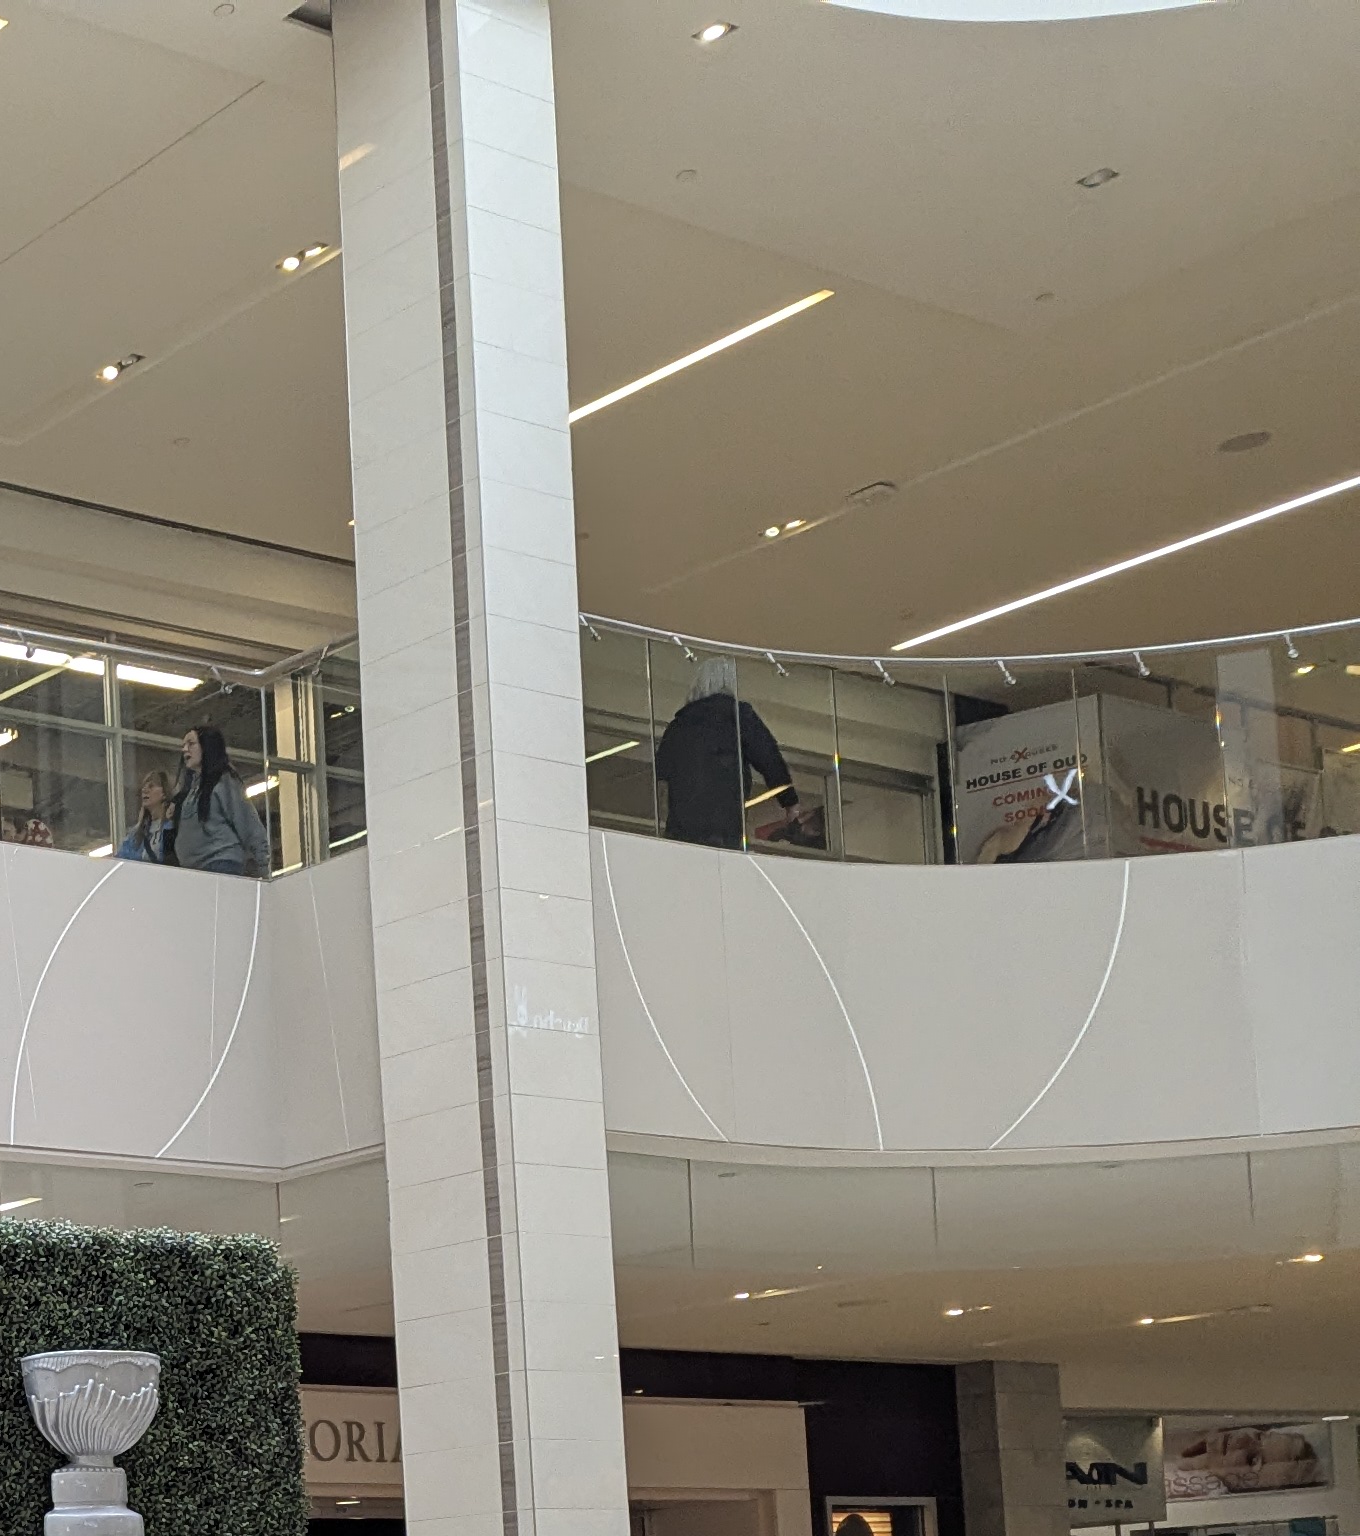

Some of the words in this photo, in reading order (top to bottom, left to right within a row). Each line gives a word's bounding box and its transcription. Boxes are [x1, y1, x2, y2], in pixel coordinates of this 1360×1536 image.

[966, 770, 1022, 790] HOUSE
[1027, 761, 1047, 775] OF
[1053, 754, 1088, 769] OUD
[993, 786, 1065, 807] COMIN
[1136, 786, 1256, 846] HOUSE
